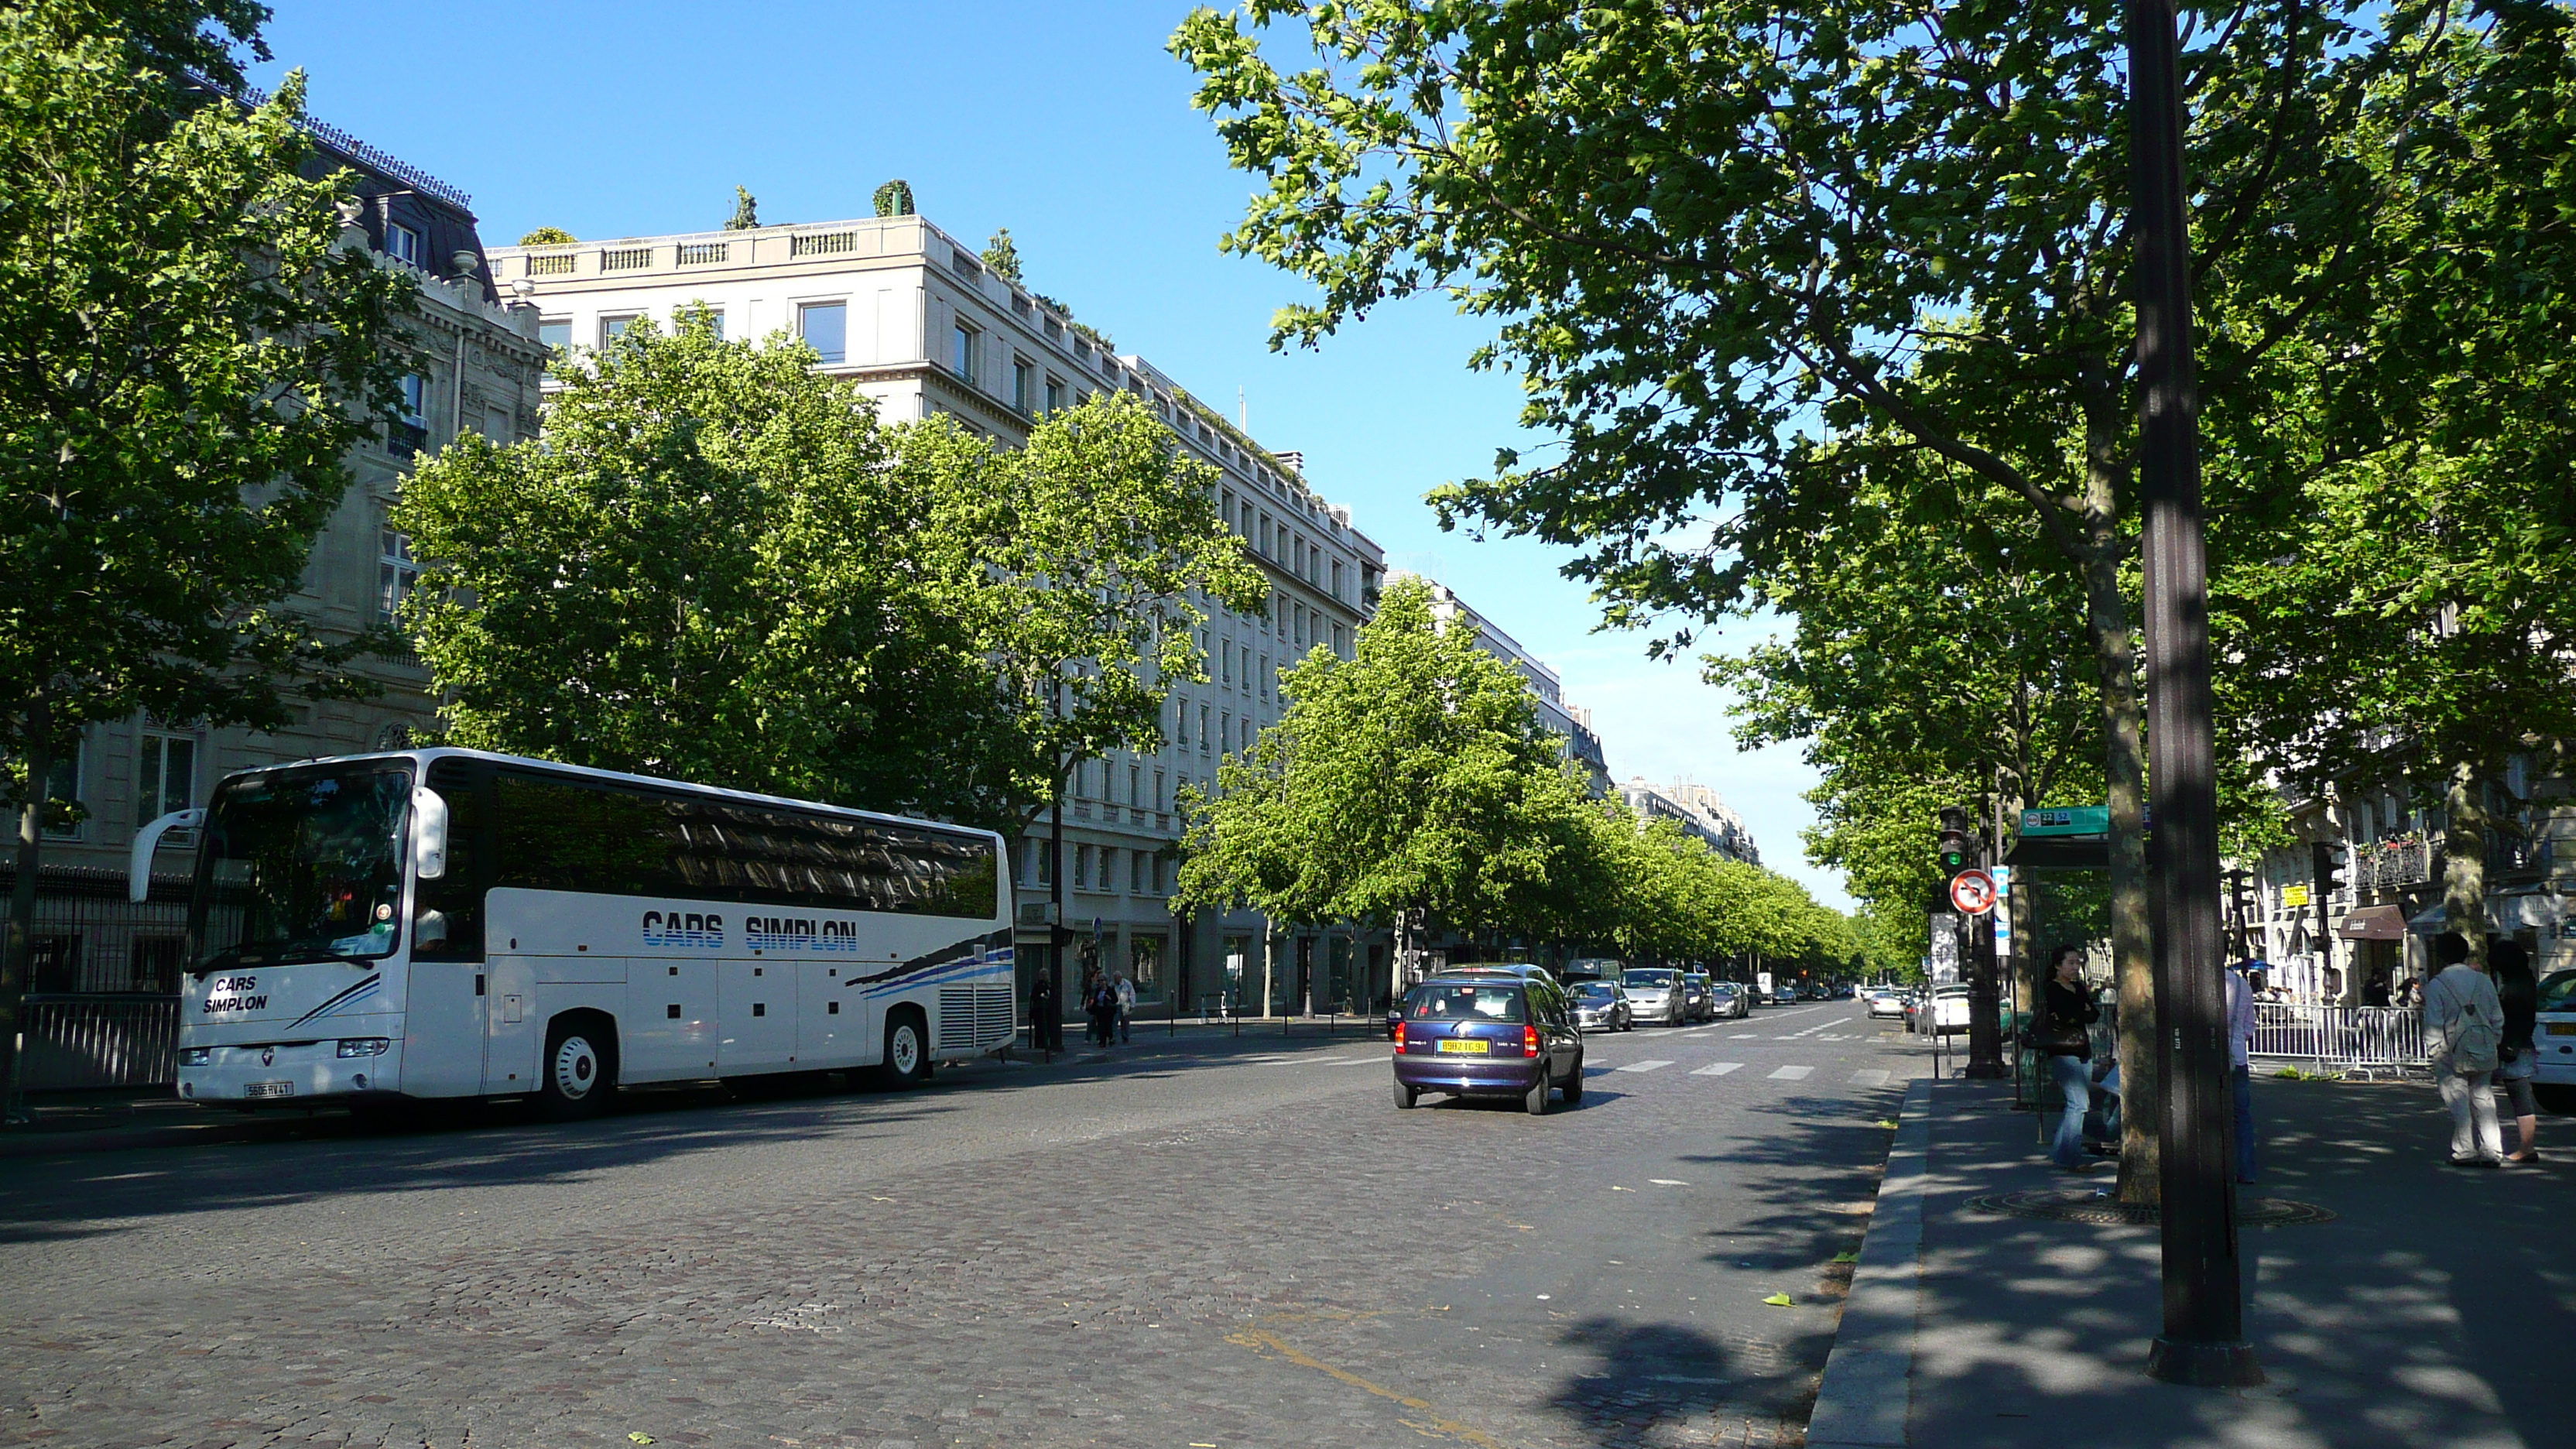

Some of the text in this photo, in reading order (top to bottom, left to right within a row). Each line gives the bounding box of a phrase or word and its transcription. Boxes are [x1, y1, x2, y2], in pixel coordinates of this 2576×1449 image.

[642, 910, 857, 951] CARS SIMPLON
[216, 976, 256, 992] CARS
[203, 995, 268, 1013] SIMPLON
